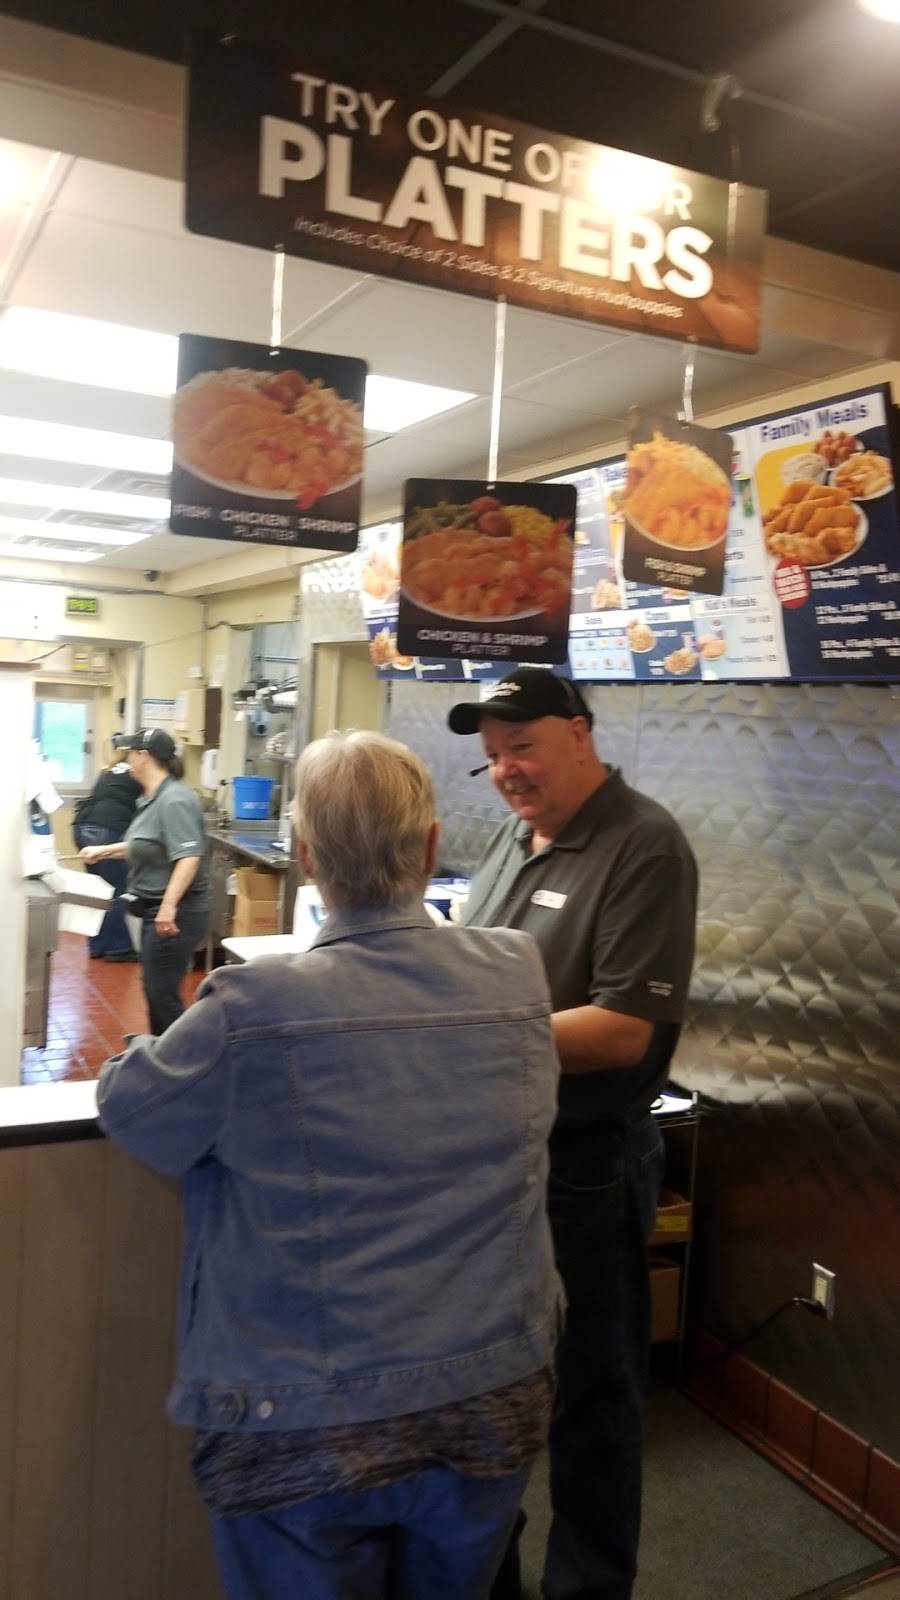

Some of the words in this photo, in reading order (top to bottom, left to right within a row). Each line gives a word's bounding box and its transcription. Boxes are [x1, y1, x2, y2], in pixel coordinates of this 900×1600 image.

[291, 72, 396, 136] TRY
[407, 109, 513, 172] ONE
[524, 143, 588, 189] OF
[259, 114, 714, 299] PLATTERS
[294, 216, 367, 246] Includes
[366, 233, 423, 259] Choice
[423, 249, 446, 262] of
[441, 252, 458, 267] 2
[457, 254, 500, 277] Sides
[500, 264, 513, 280] &
[512, 267, 525, 283] 2
[525, 270, 596, 298] Signature
[761, 417, 810, 442] Family
[815, 402, 868, 429] Meals
[233, 525, 298, 541] PLATTER
[298, 517, 357, 534] SHRIMP
[656, 571, 695, 585] PLATTER
[416, 629, 480, 643] CHICKEN
[480, 632, 492, 644] &
[492, 633, 550, 647] SHRIMP
[452, 643, 511, 656] PLATTER
